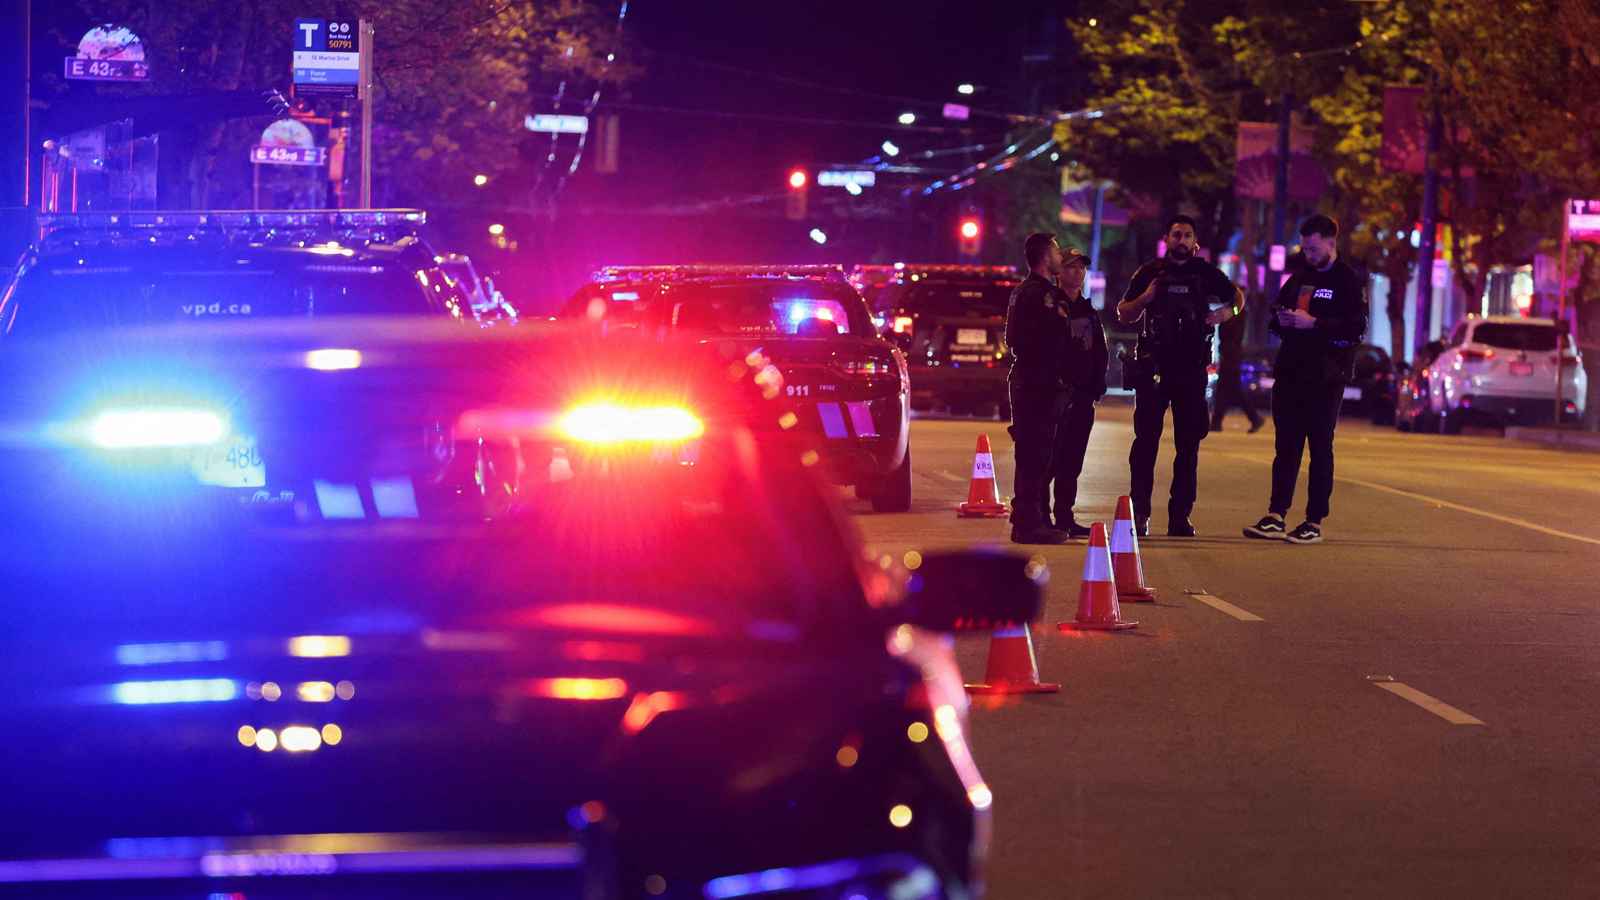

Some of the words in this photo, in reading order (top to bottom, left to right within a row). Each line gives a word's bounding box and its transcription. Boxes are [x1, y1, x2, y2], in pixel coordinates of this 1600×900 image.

[299, 23, 319, 48] T
[72, 61, 84, 75] E
[89, 62, 123, 76] 43r
[257, 148, 267, 159] E
[182, 302, 251, 316] vpd.ca
[786, 385, 809, 396] 911
